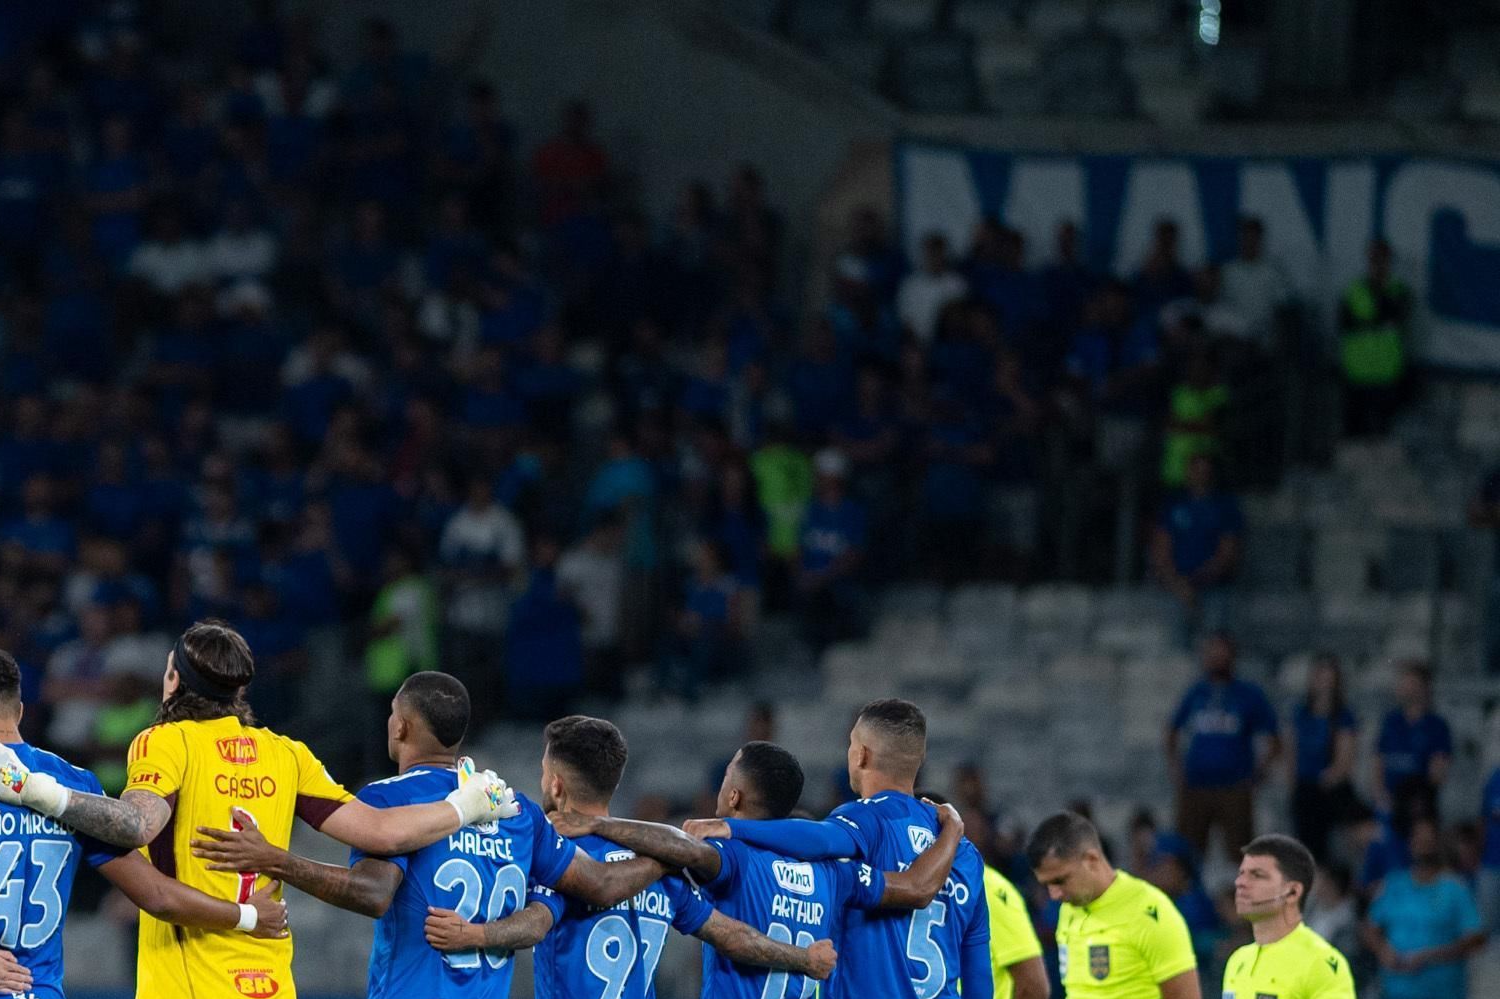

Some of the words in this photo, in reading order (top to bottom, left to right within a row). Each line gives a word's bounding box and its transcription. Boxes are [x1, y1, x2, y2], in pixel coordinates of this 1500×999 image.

[449, 831, 514, 861] WALACE
[433, 858, 527, 969] 20
[771, 894, 824, 926] ARTHUR
[239, 976, 273, 994] BH
